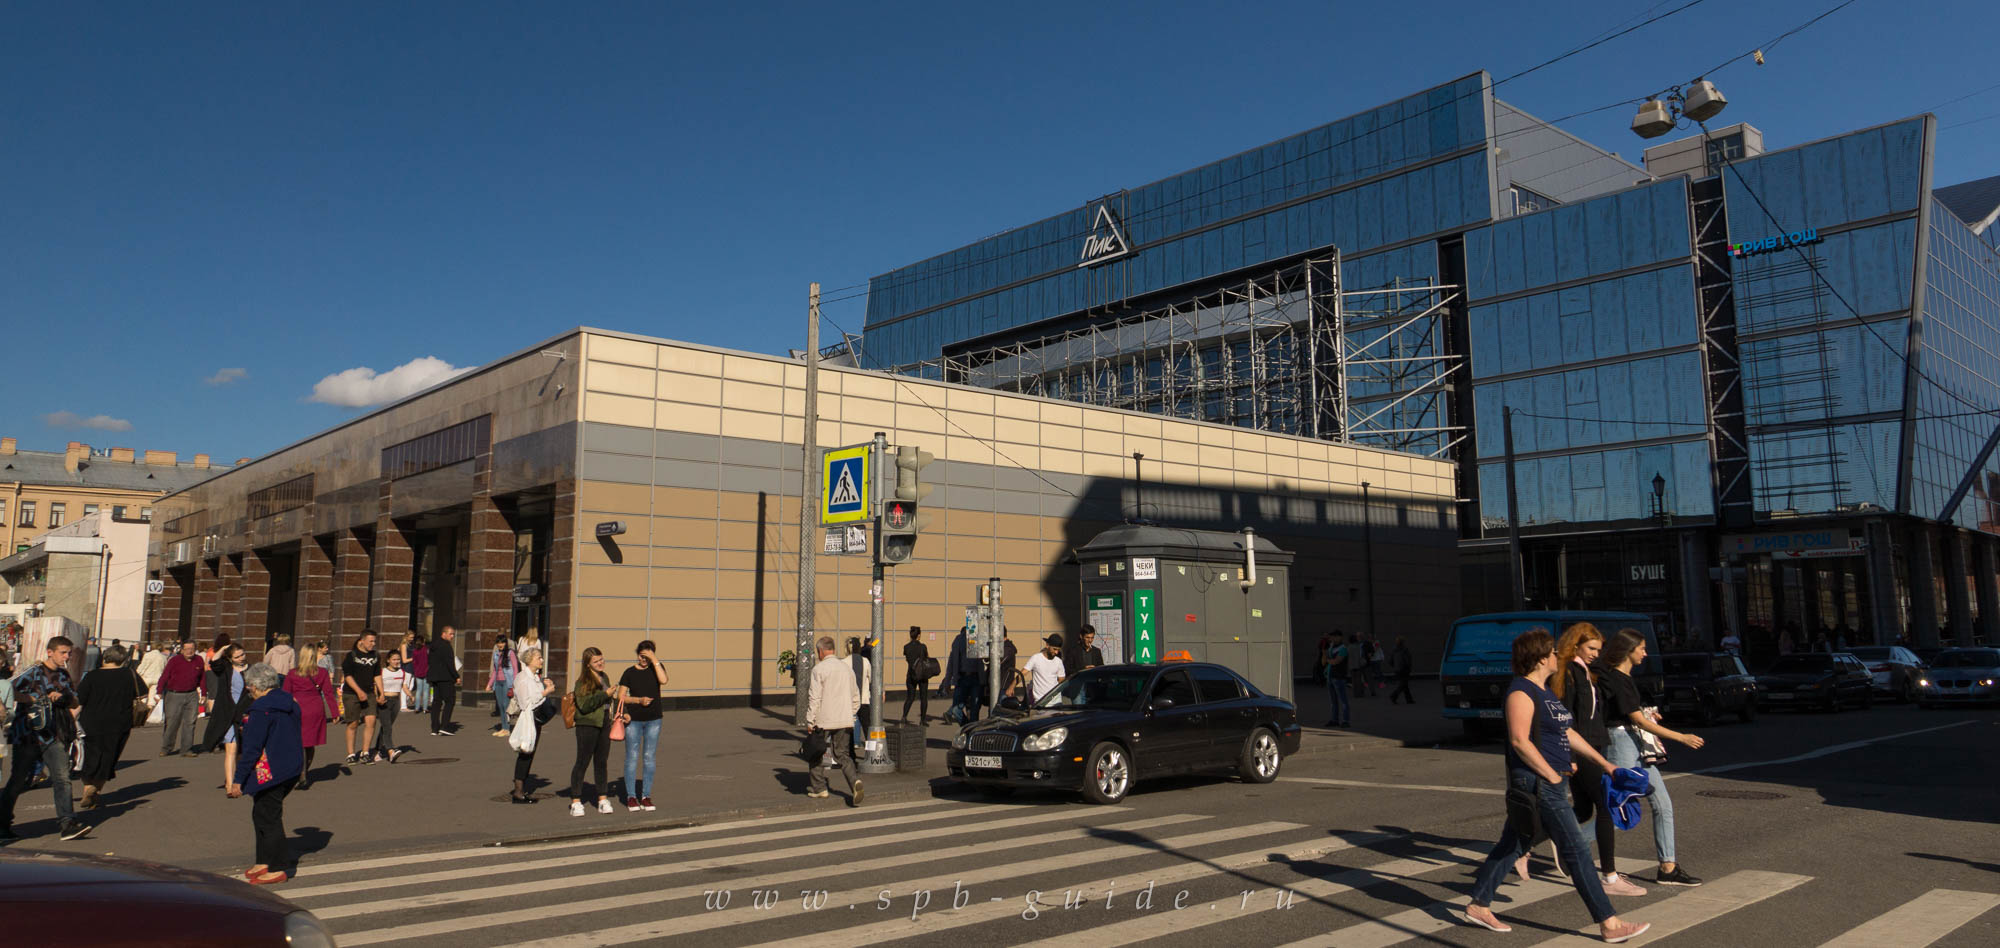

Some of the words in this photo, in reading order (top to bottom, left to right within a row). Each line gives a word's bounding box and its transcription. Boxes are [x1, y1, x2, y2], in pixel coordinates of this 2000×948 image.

[1742, 236, 1777, 254] РИВ
[1754, 535, 1790, 550] РИВ
[1792, 531, 1832, 549] ГОШ
[1136, 562, 1154, 570] ЧЕКИ
[1631, 564, 1666, 580] БУШЕ
